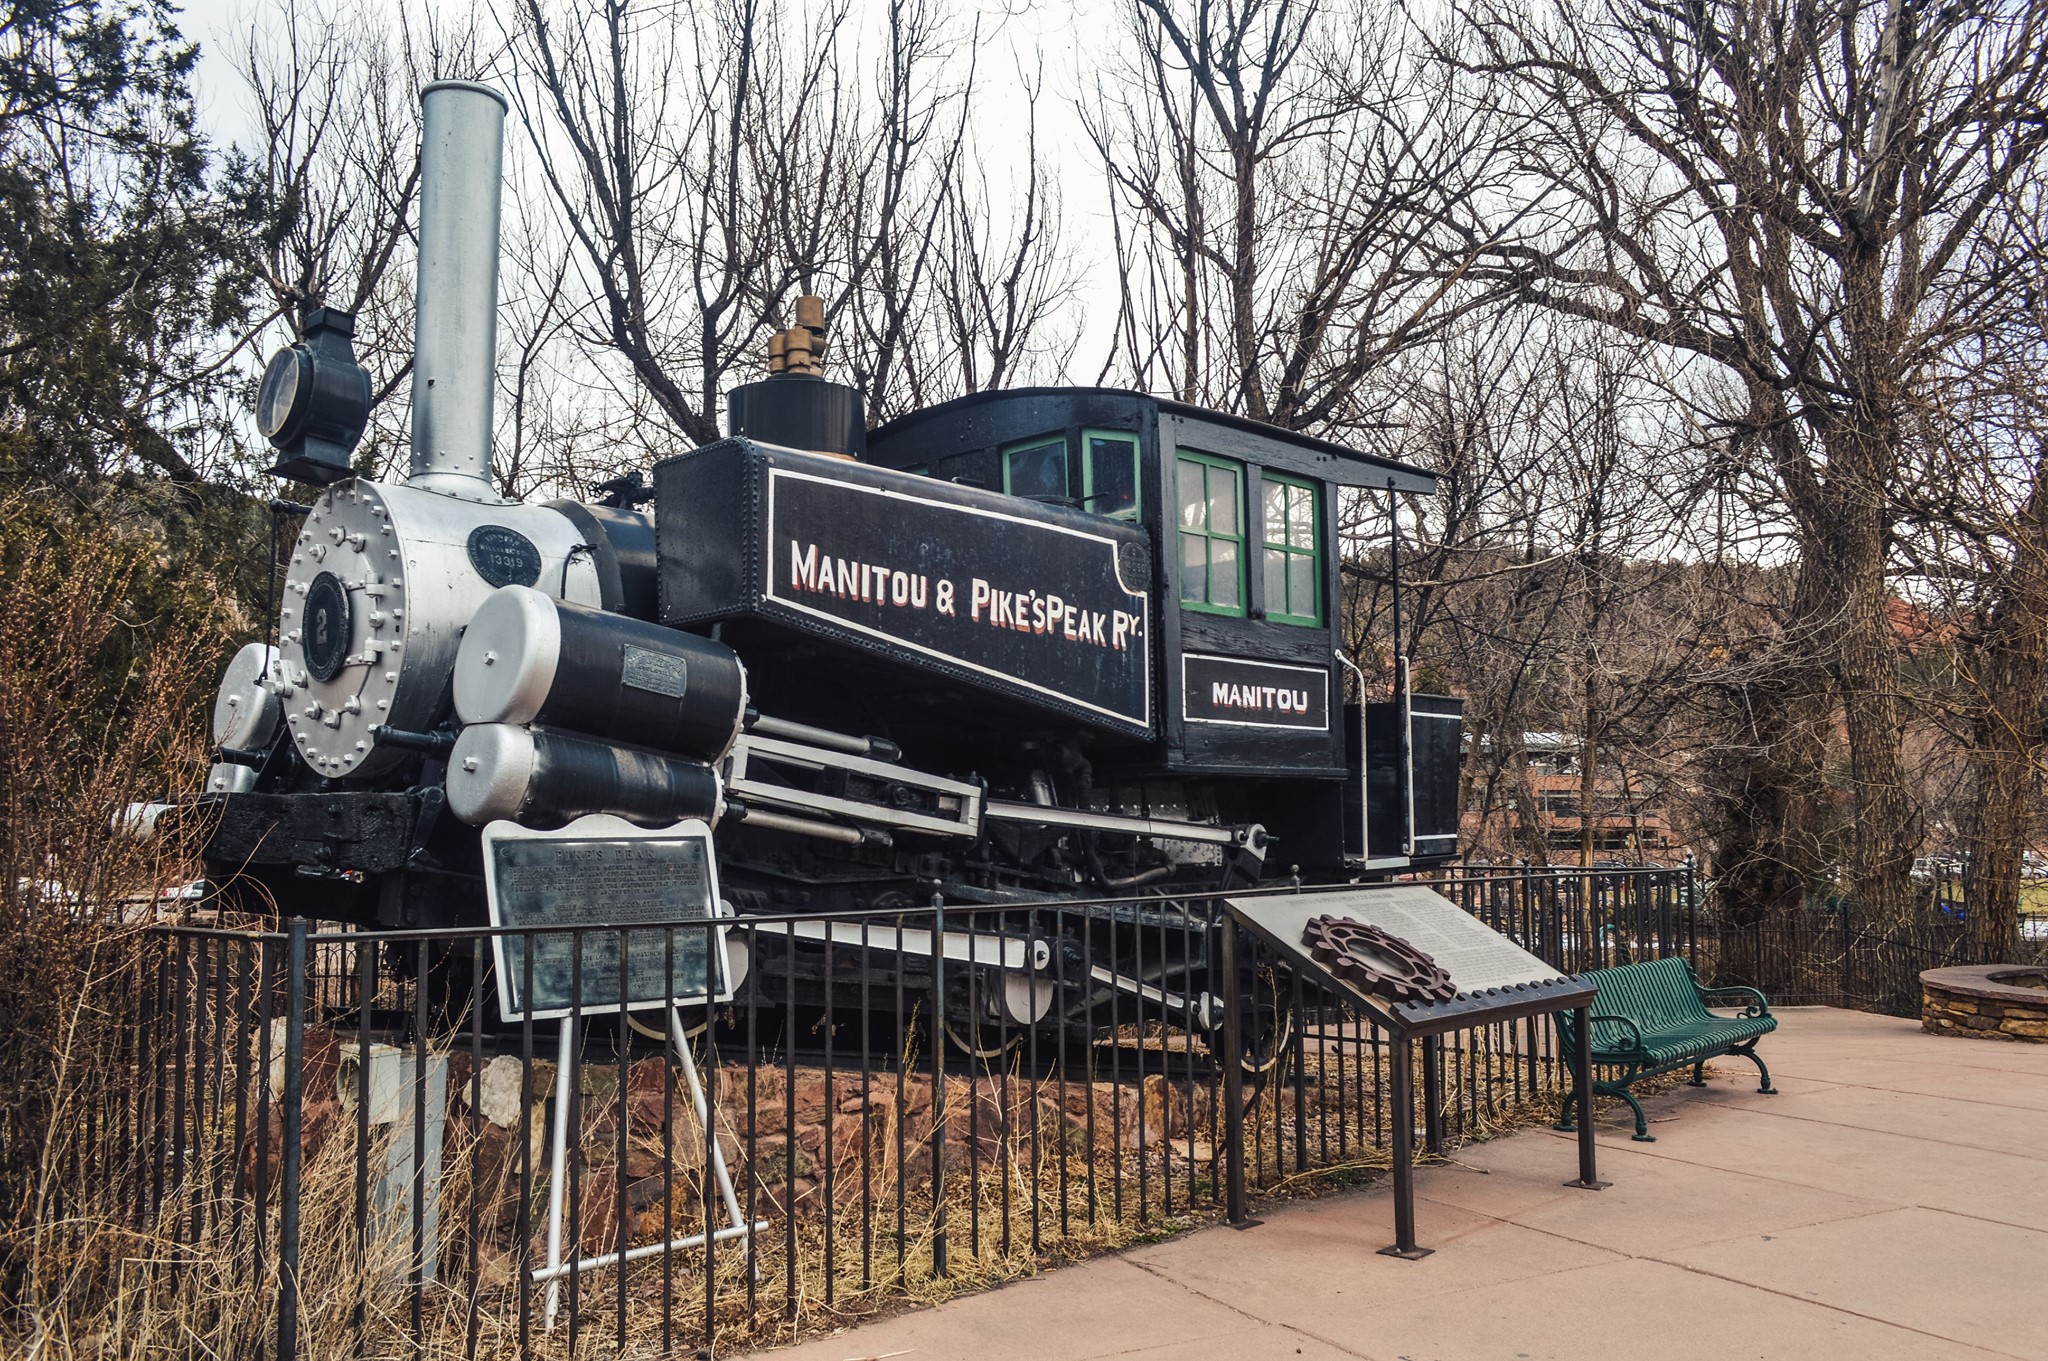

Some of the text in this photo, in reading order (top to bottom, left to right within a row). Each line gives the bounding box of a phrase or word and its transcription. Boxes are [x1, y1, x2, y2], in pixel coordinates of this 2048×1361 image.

[488, 554, 524, 568] 13319
[791, 540, 927, 607] MANITOU
[936, 579, 955, 617] &
[316, 608, 328, 645] 2
[1212, 682, 1308, 715] MANITOU
[555, 848, 656, 862] PIKE'S PEAK
